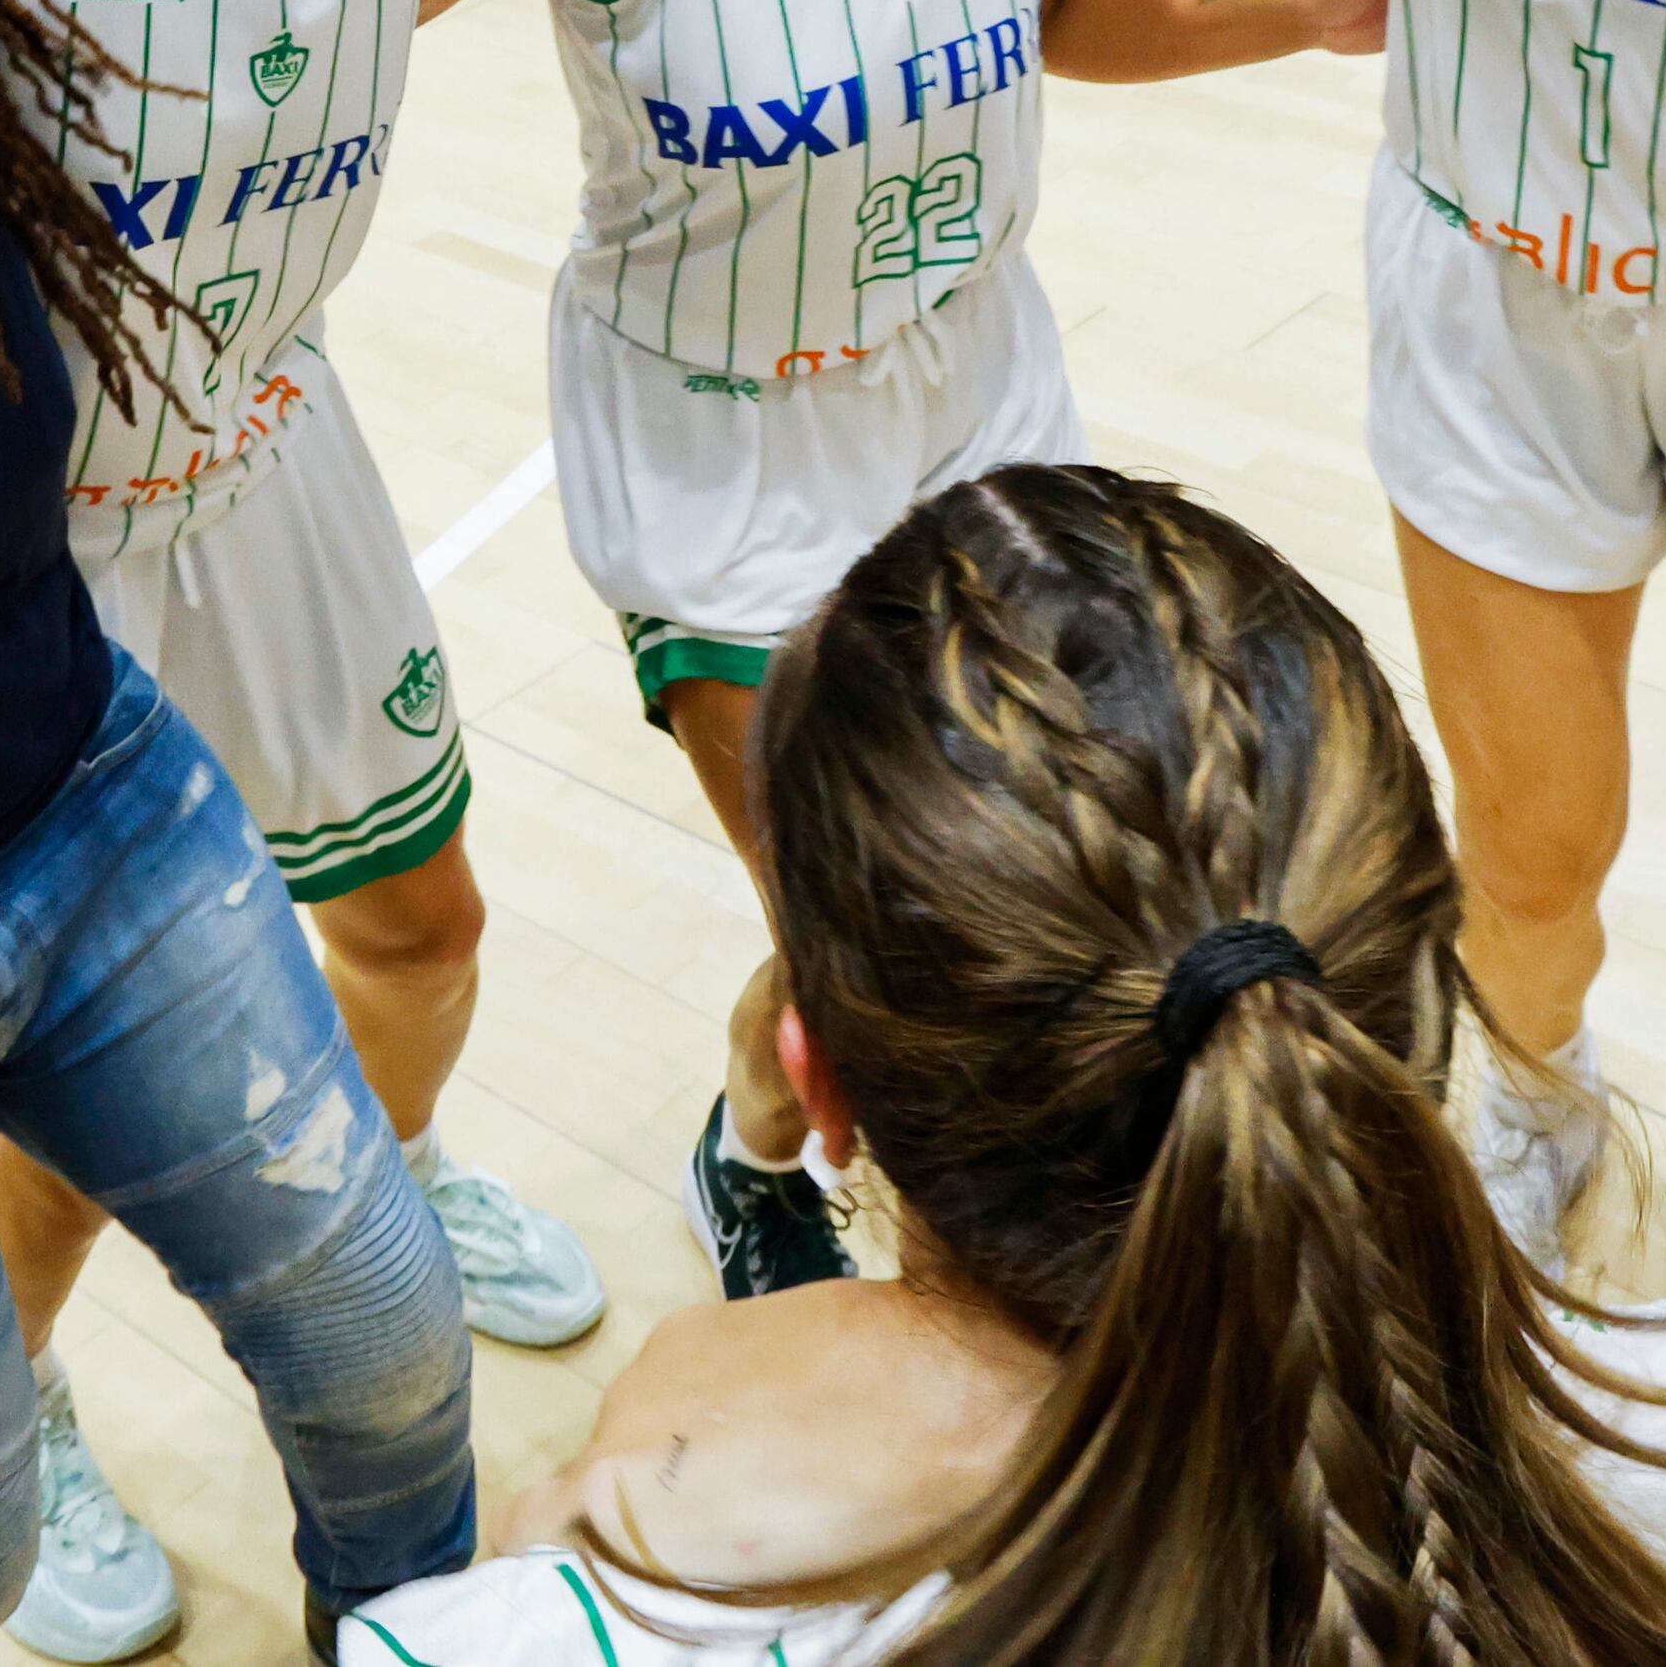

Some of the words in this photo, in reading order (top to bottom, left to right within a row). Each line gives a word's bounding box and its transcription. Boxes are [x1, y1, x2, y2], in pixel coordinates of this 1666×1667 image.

[642, 74, 868, 170] BAXI
[1574, 41, 1614, 169] 1
[88, 174, 205, 251] XI
[852, 151, 983, 290] 22
[195, 269, 261, 397] 7
